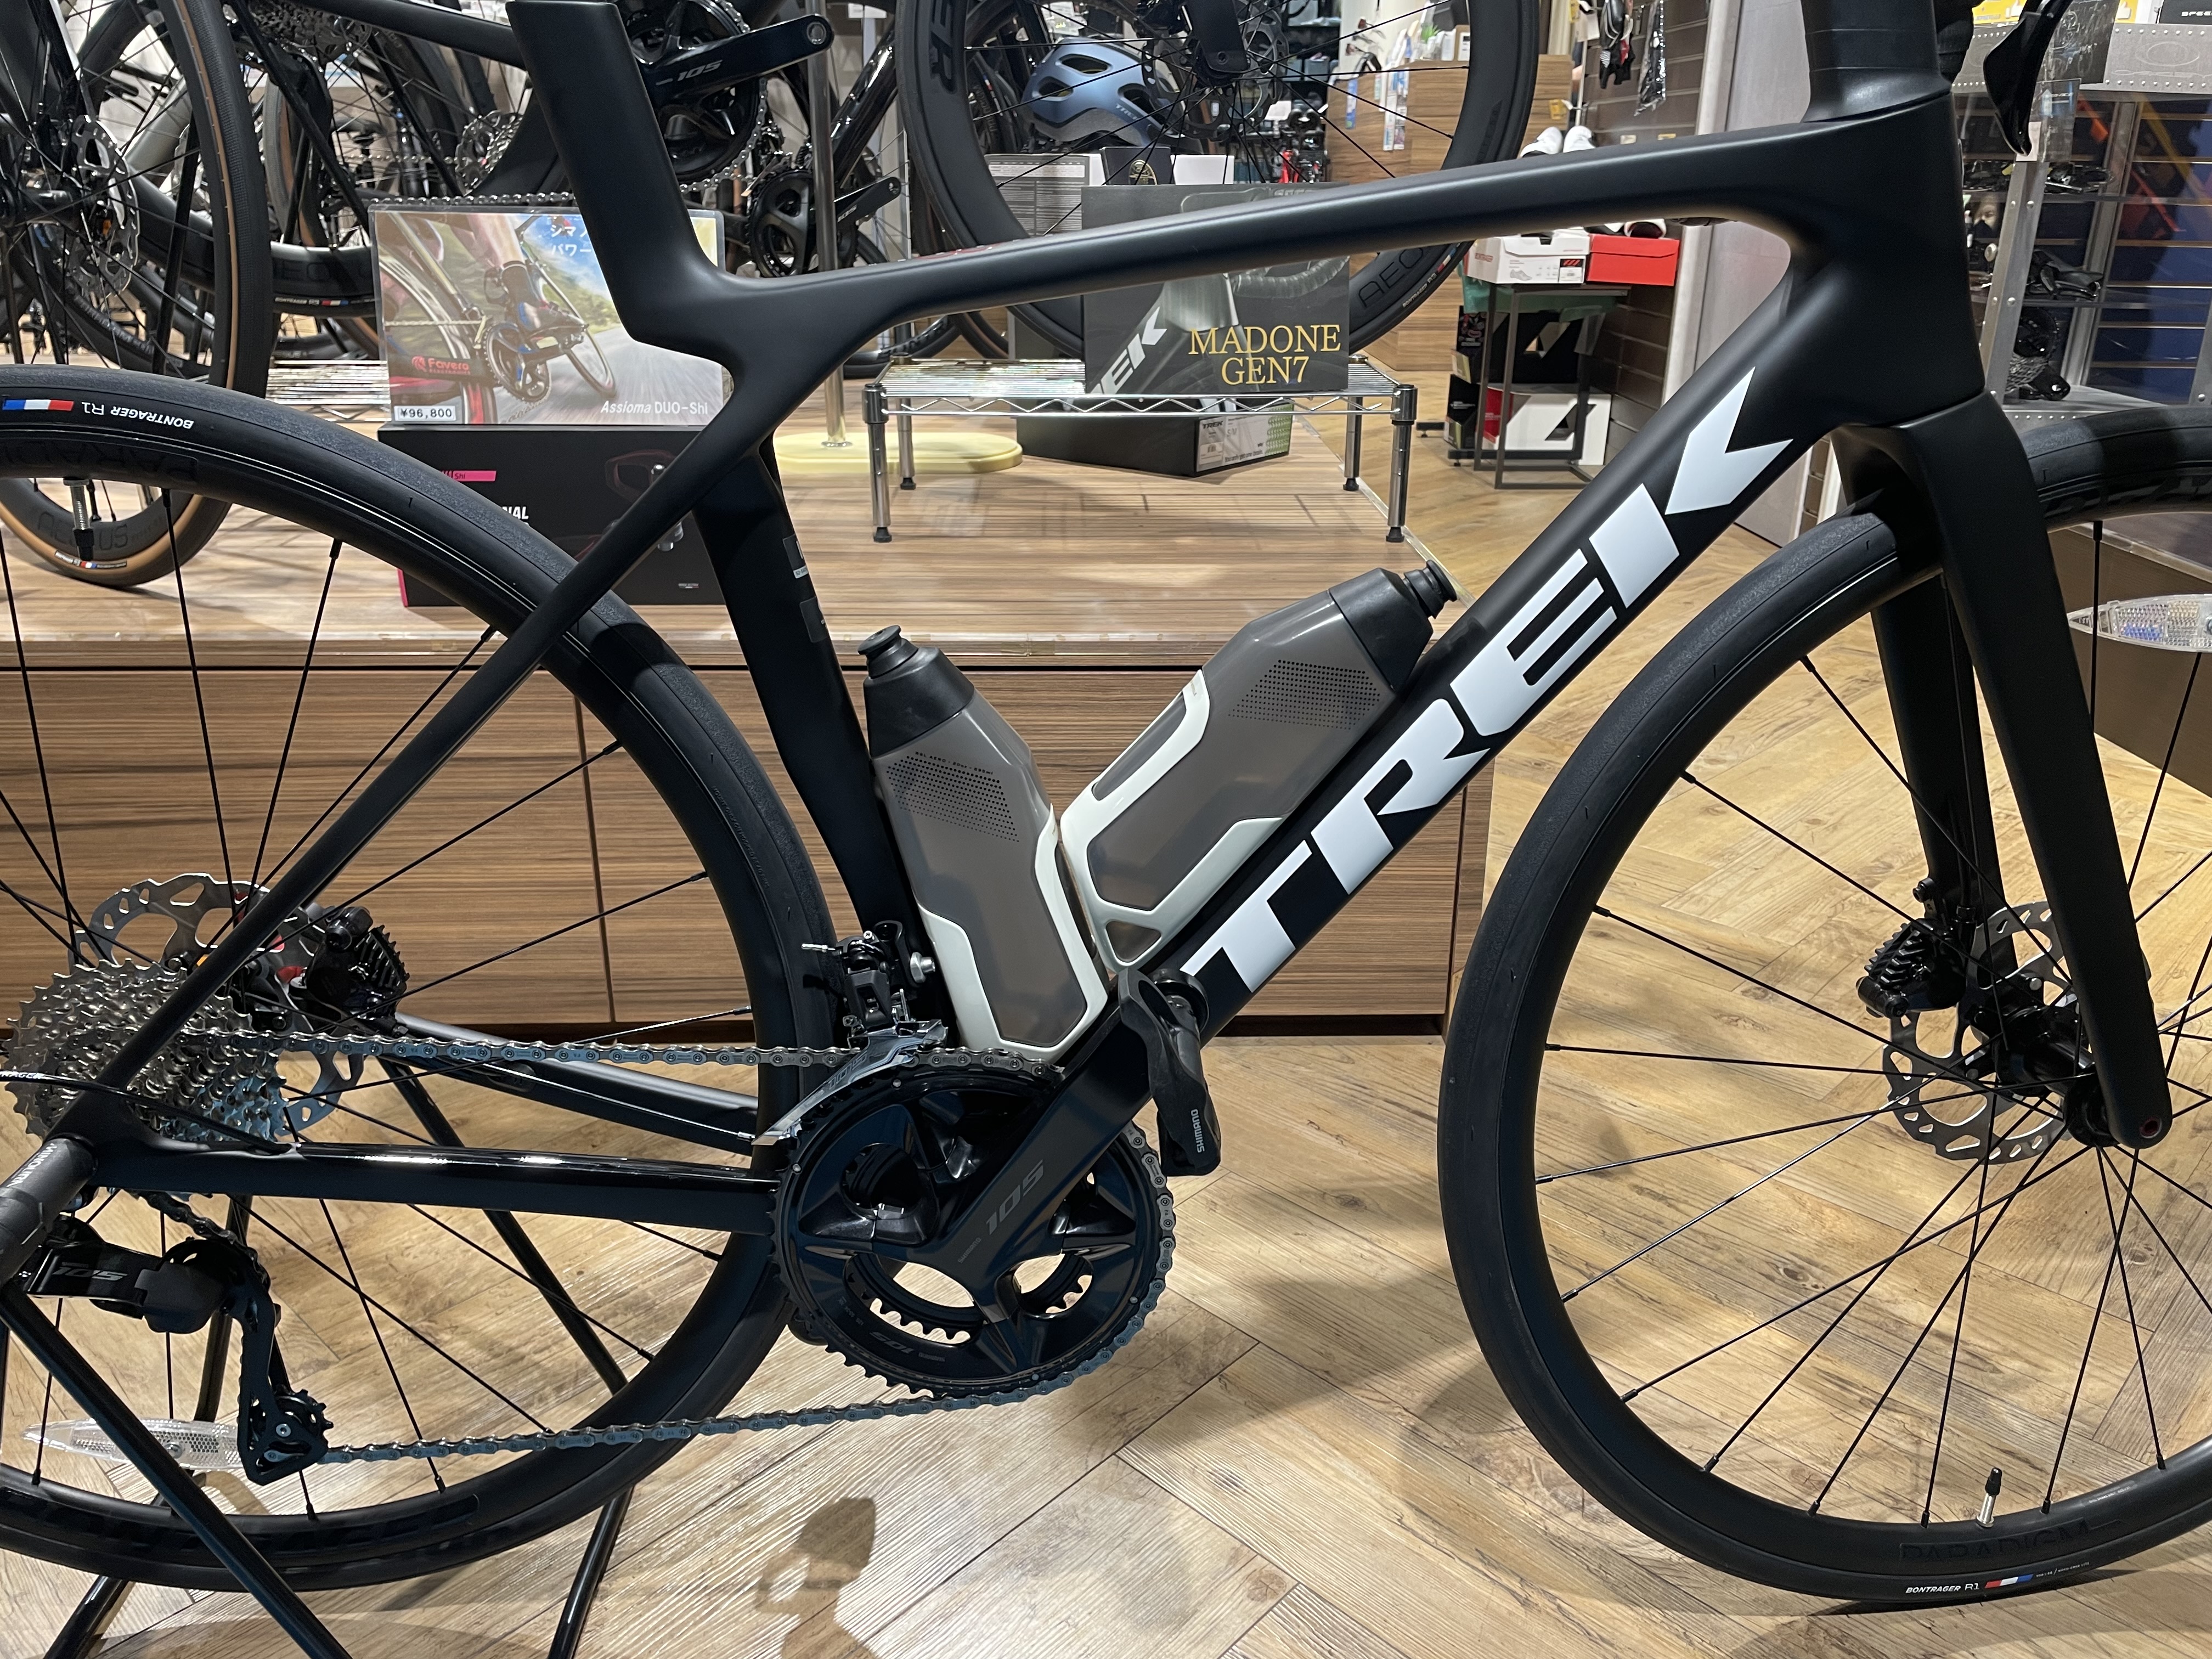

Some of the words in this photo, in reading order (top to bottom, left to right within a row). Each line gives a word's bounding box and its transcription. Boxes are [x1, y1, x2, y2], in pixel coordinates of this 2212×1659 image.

[677, 60, 723, 81] 105
[1093, 306, 1167, 394] EK
[1188, 324, 1341, 356] MADONE
[428, 358, 469, 370] Favero
[1221, 356, 1310, 386] GEN7
[82, 402, 104, 415] R1
[110, 406, 194, 429] BONTRAGER
[400, 408, 452, 419] ¥96,800
[601, 400, 652, 414] Assioma
[654, 401, 708, 415] DUO-Shi
[1203, 420, 1224, 430] TREK
[1180, 366, 1793, 992] TREK
[1190, 1109, 1205, 1153] SHIMANO
[6, 1143, 57, 1187] MINOURA
[986, 1158, 1044, 1235] 105
[52, 1266, 128, 1282] 105
[869, 1331, 914, 1354] 105
[1905, 1585, 1961, 1594] BONTRAGER
[1965, 1583, 1979, 1592] R1
